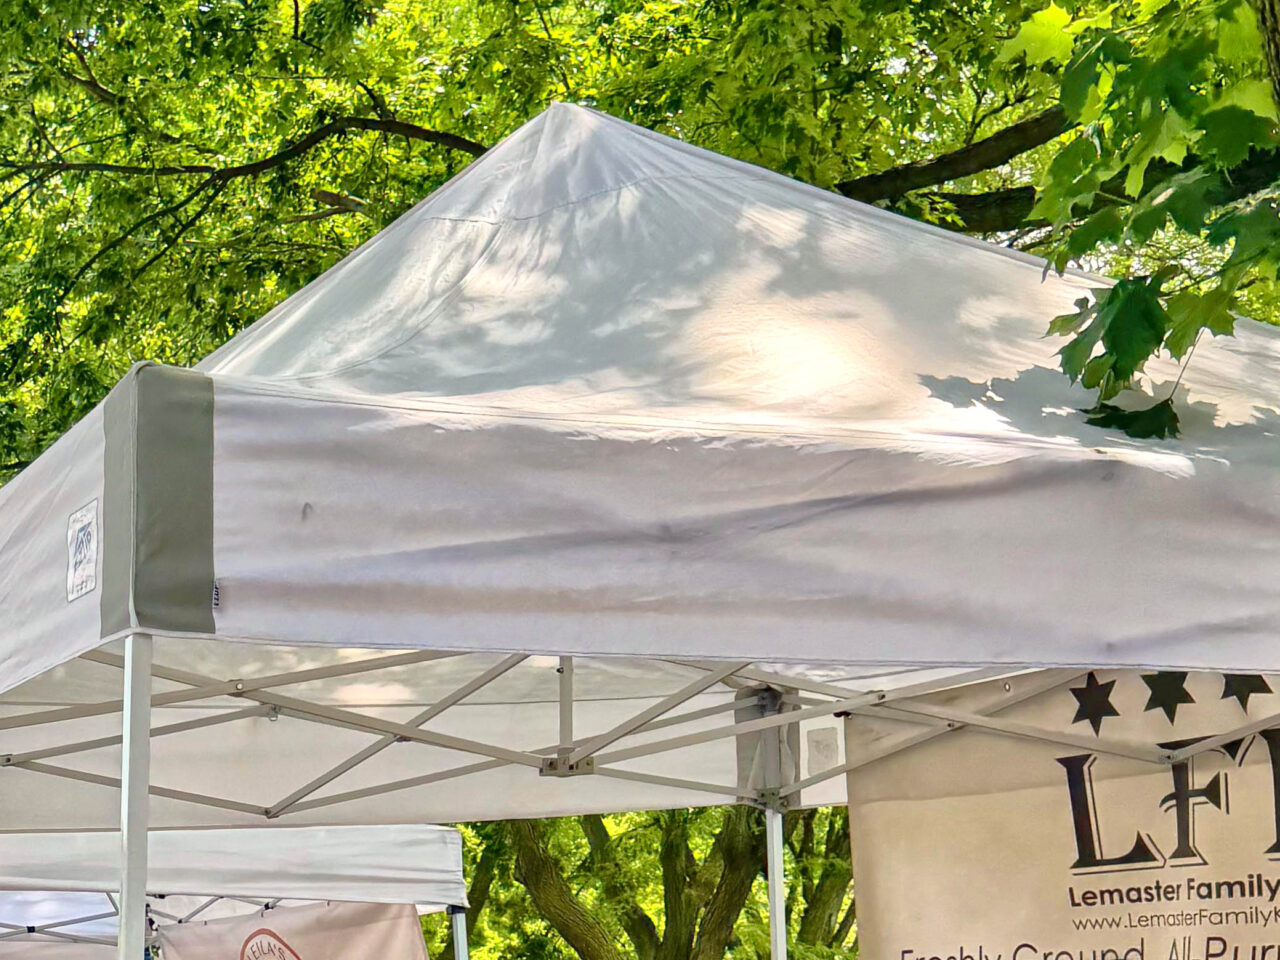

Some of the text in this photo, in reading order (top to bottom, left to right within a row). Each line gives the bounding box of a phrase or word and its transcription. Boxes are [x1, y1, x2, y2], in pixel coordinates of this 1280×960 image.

[1056, 728, 1280, 877] LF
[1068, 872, 1280, 908] Lemaster Family
